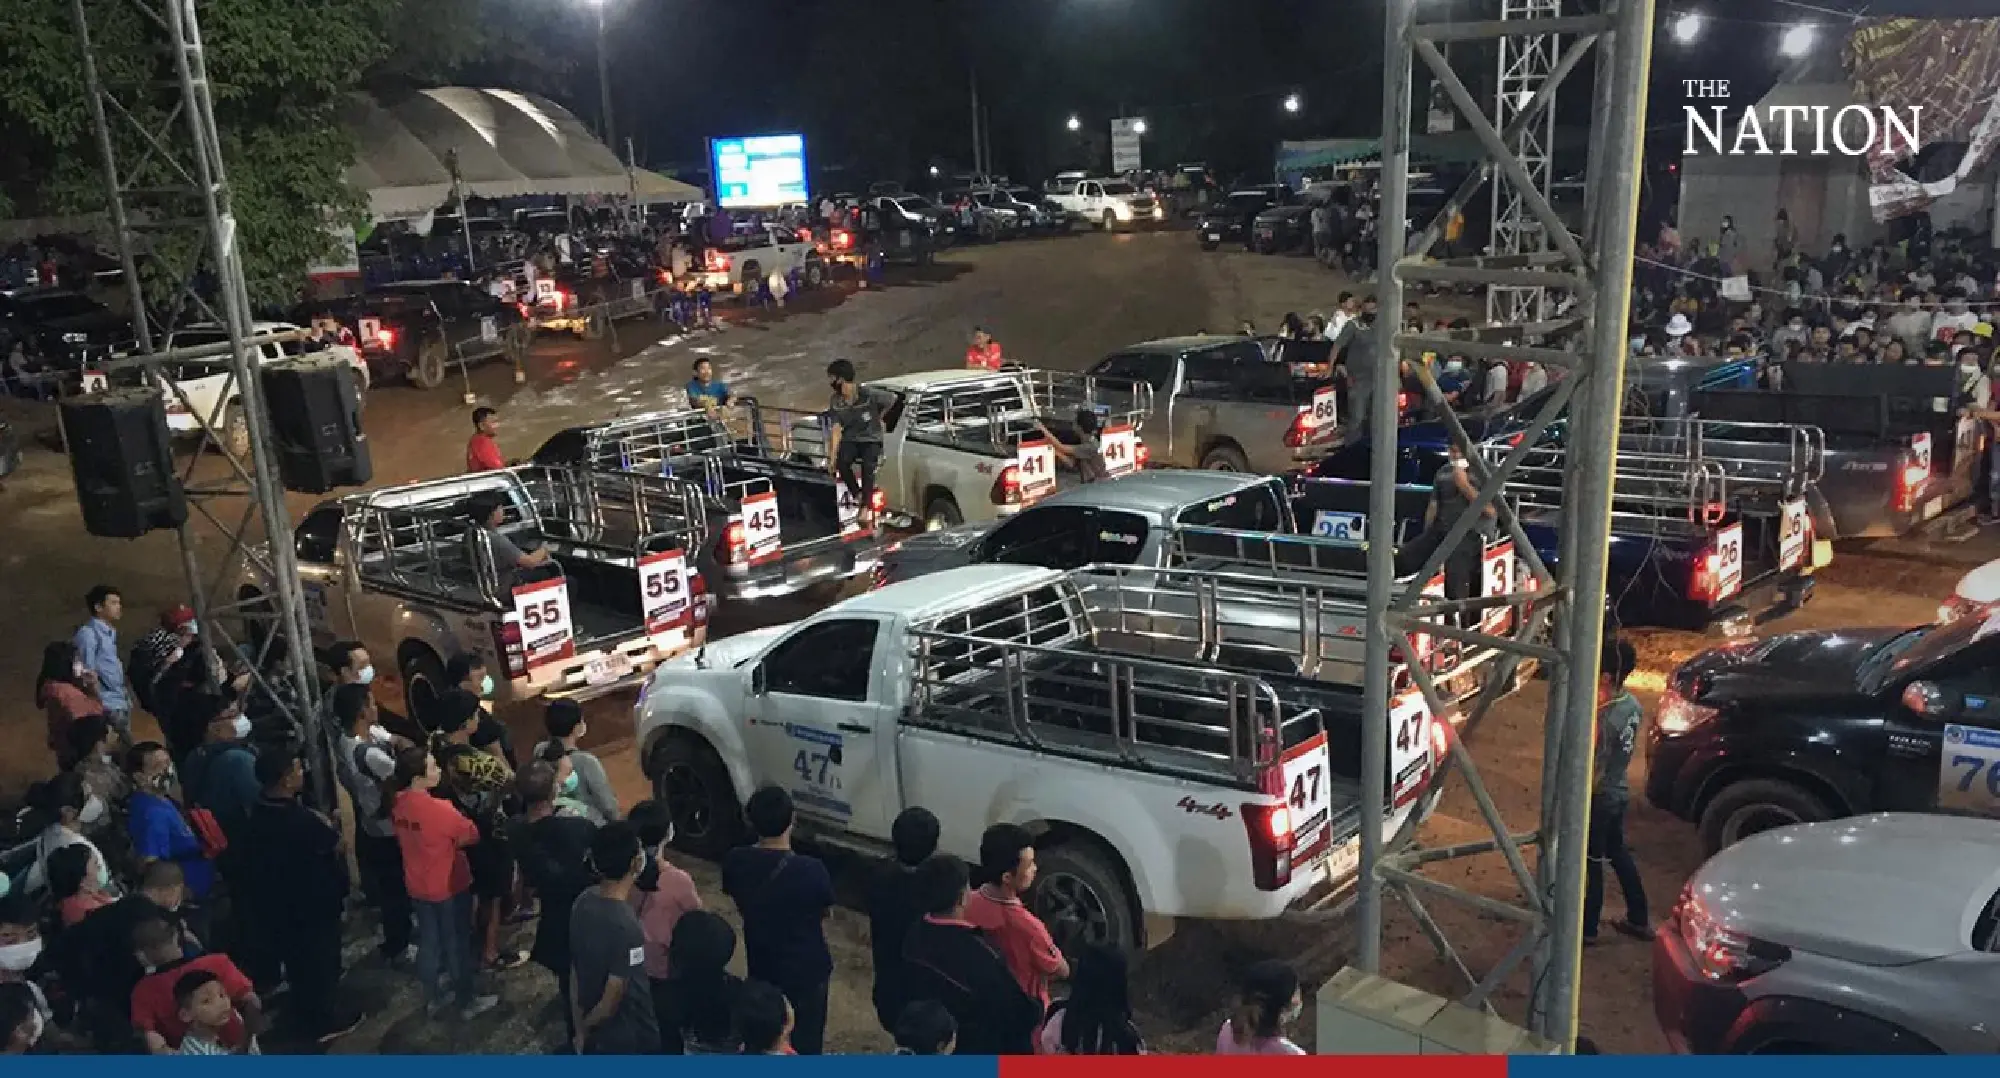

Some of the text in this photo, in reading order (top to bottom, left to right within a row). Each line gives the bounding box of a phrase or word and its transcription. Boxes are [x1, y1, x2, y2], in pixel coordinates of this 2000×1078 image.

[1315, 400, 1333, 419] 66
[1105, 441, 1126, 460] 41
[1022, 455, 1045, 475] 41
[749, 508, 775, 531] 45
[1319, 521, 1349, 540] 26
[1720, 539, 1738, 567] 26
[646, 569, 679, 597] 55
[1491, 558, 1506, 594] 3
[523, 599, 560, 628] 55
[1396, 711, 1423, 752] 47
[794, 749, 829, 784] 47
[1289, 764, 1321, 808] 47
